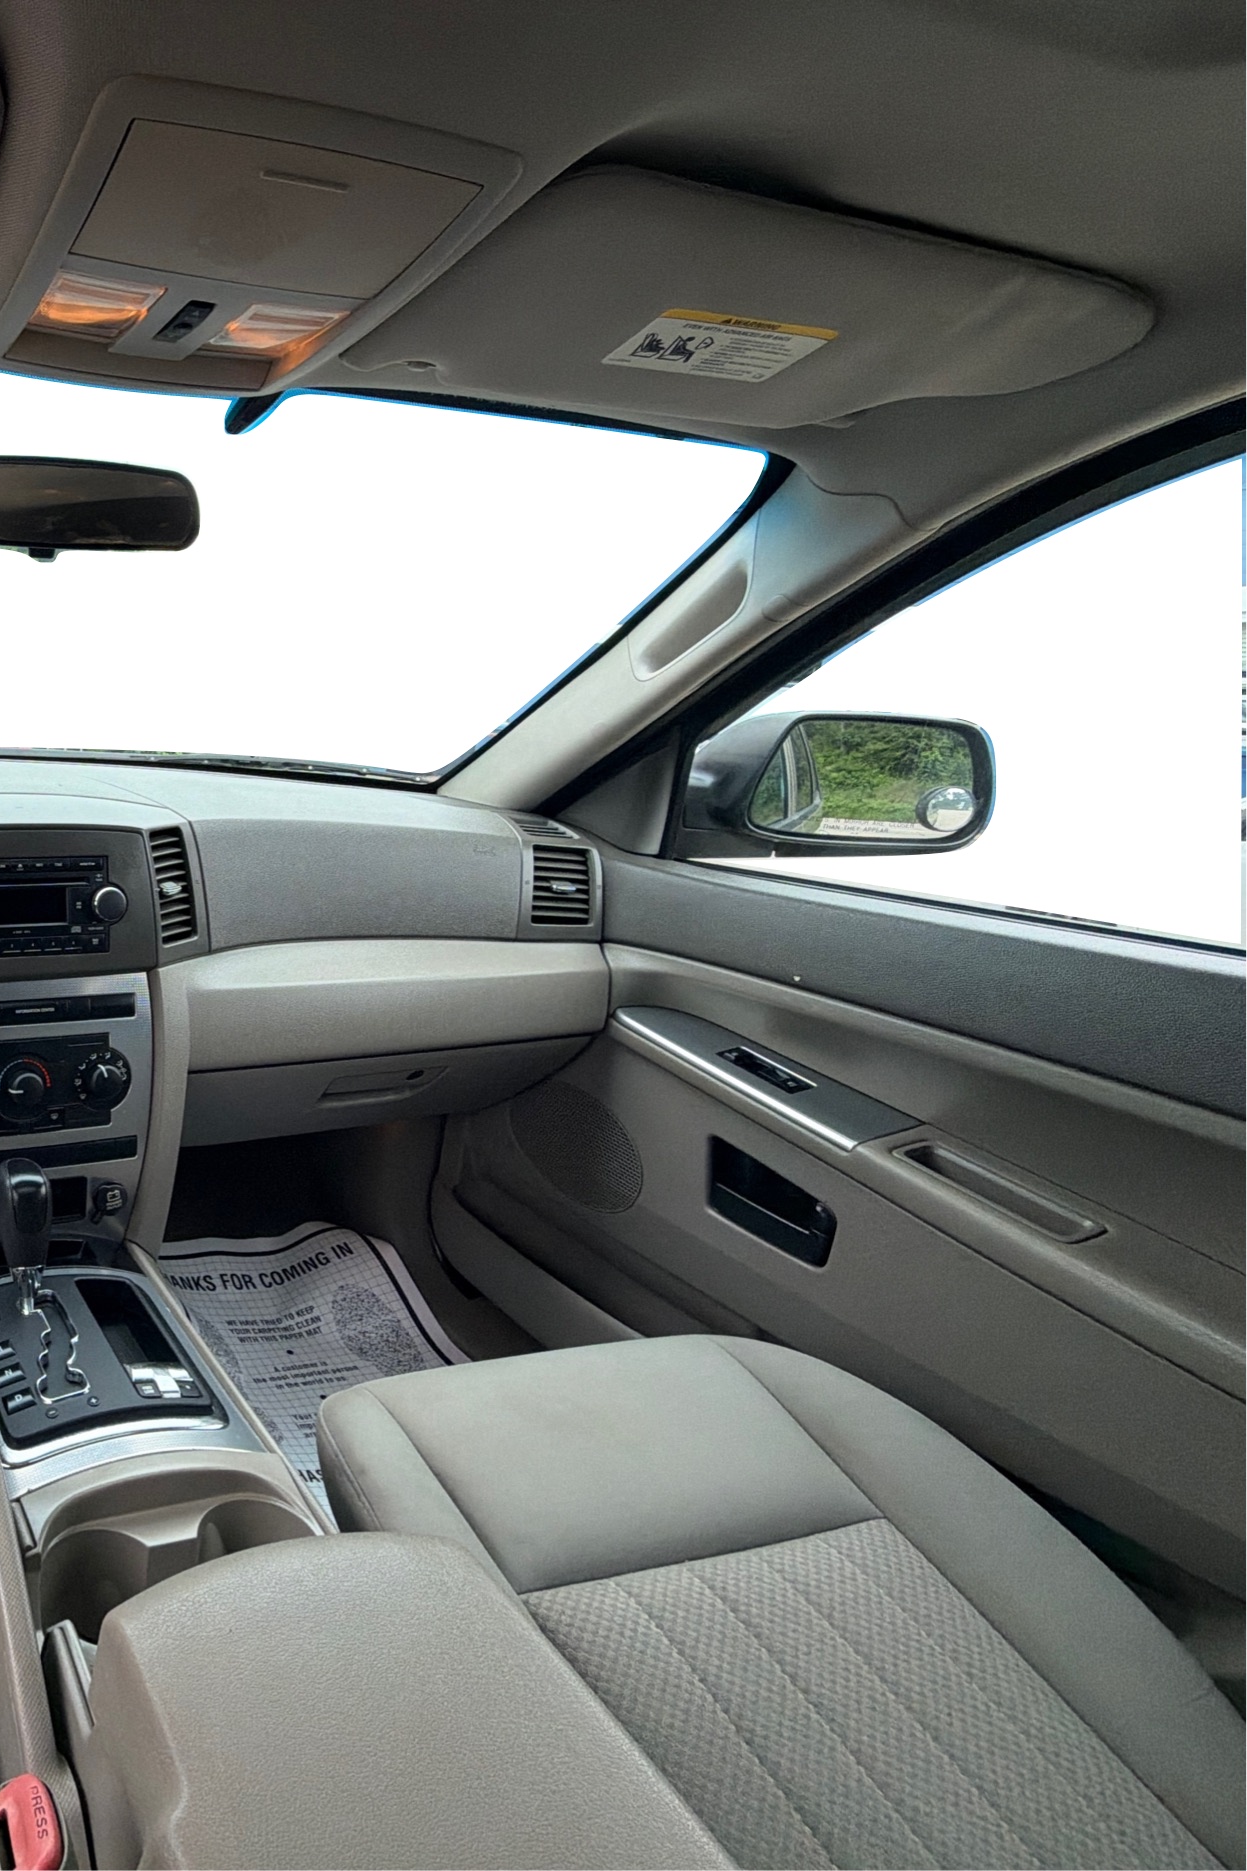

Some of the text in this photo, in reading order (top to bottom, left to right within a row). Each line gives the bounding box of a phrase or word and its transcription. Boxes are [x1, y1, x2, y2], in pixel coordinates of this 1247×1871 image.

[732, 318, 781, 330] WARNING
[165, 1241, 354, 1292] ANKS FOR COMING IN
[260, 1317, 283, 1326] TRIED
[283, 1312, 295, 1322] TO
[295, 1305, 315, 1318] KEEP
[252, 1324, 295, 1334] CARPETING
[295, 1315, 322, 1330] CLEAN
[278, 1332, 304, 1340] PAPER
[304, 1326, 323, 1337] MAT
[5, 1369, 12, 1377] N
[268, 1374, 290, 1382] most
[291, 1369, 330, 1379] important
[331, 1366, 359, 1374] person
[282, 1363, 318, 1372] customer
[300, 1378, 324, 1386] world
[14, 1394, 22, 1402] D
[30, 1785, 49, 1839] PRESS
